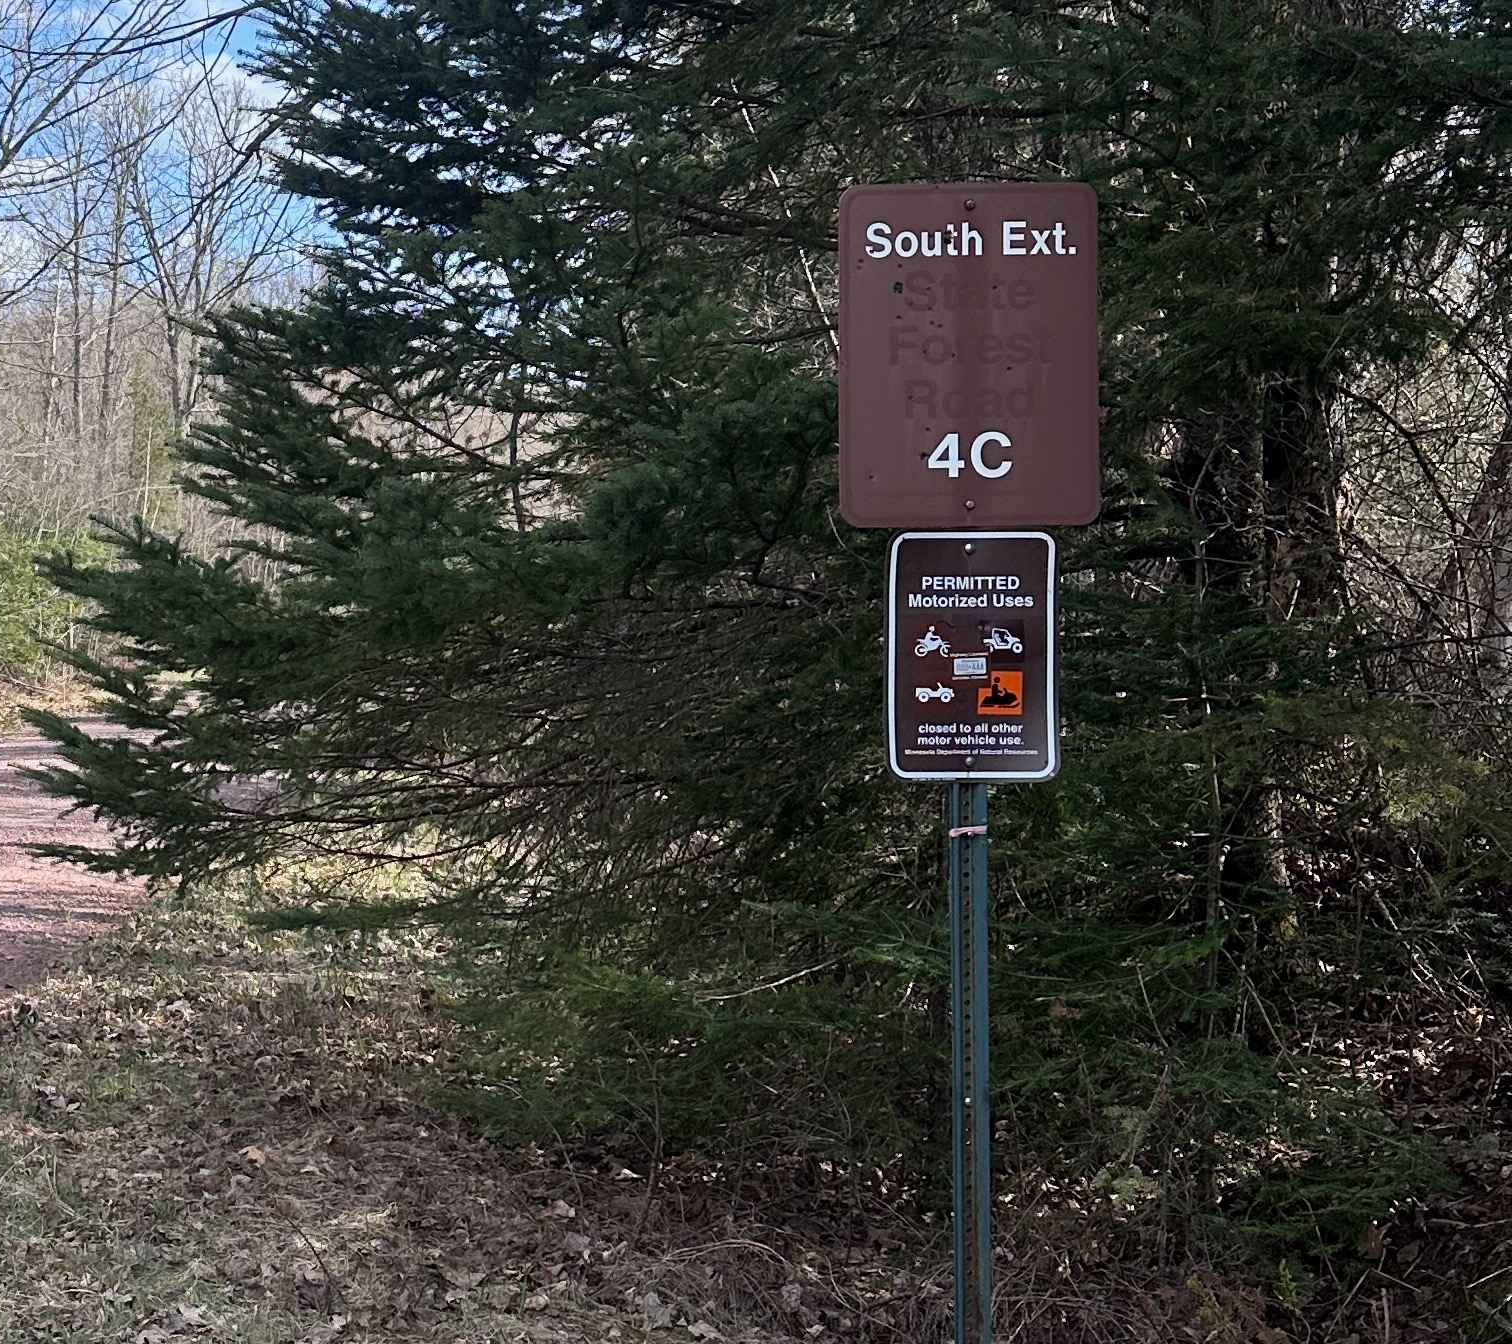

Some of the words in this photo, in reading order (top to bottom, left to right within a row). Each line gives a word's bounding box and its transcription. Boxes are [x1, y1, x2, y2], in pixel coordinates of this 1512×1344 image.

[865, 221, 983, 259] South
[1002, 220, 1078, 256] Ext.
[927, 430, 1013, 479] 4C
[921, 576, 1020, 590] PERMITTED
[908, 594, 987, 608] Motorized
[993, 594, 1034, 608] Uses
[918, 723, 957, 734] closed
[959, 723, 971, 734] to
[974, 723, 988, 734] all
[991, 723, 1023, 734] other
[917, 736, 952, 746] motor
[954, 735, 996, 746] vehicle
[999, 737, 1024, 746] use.
